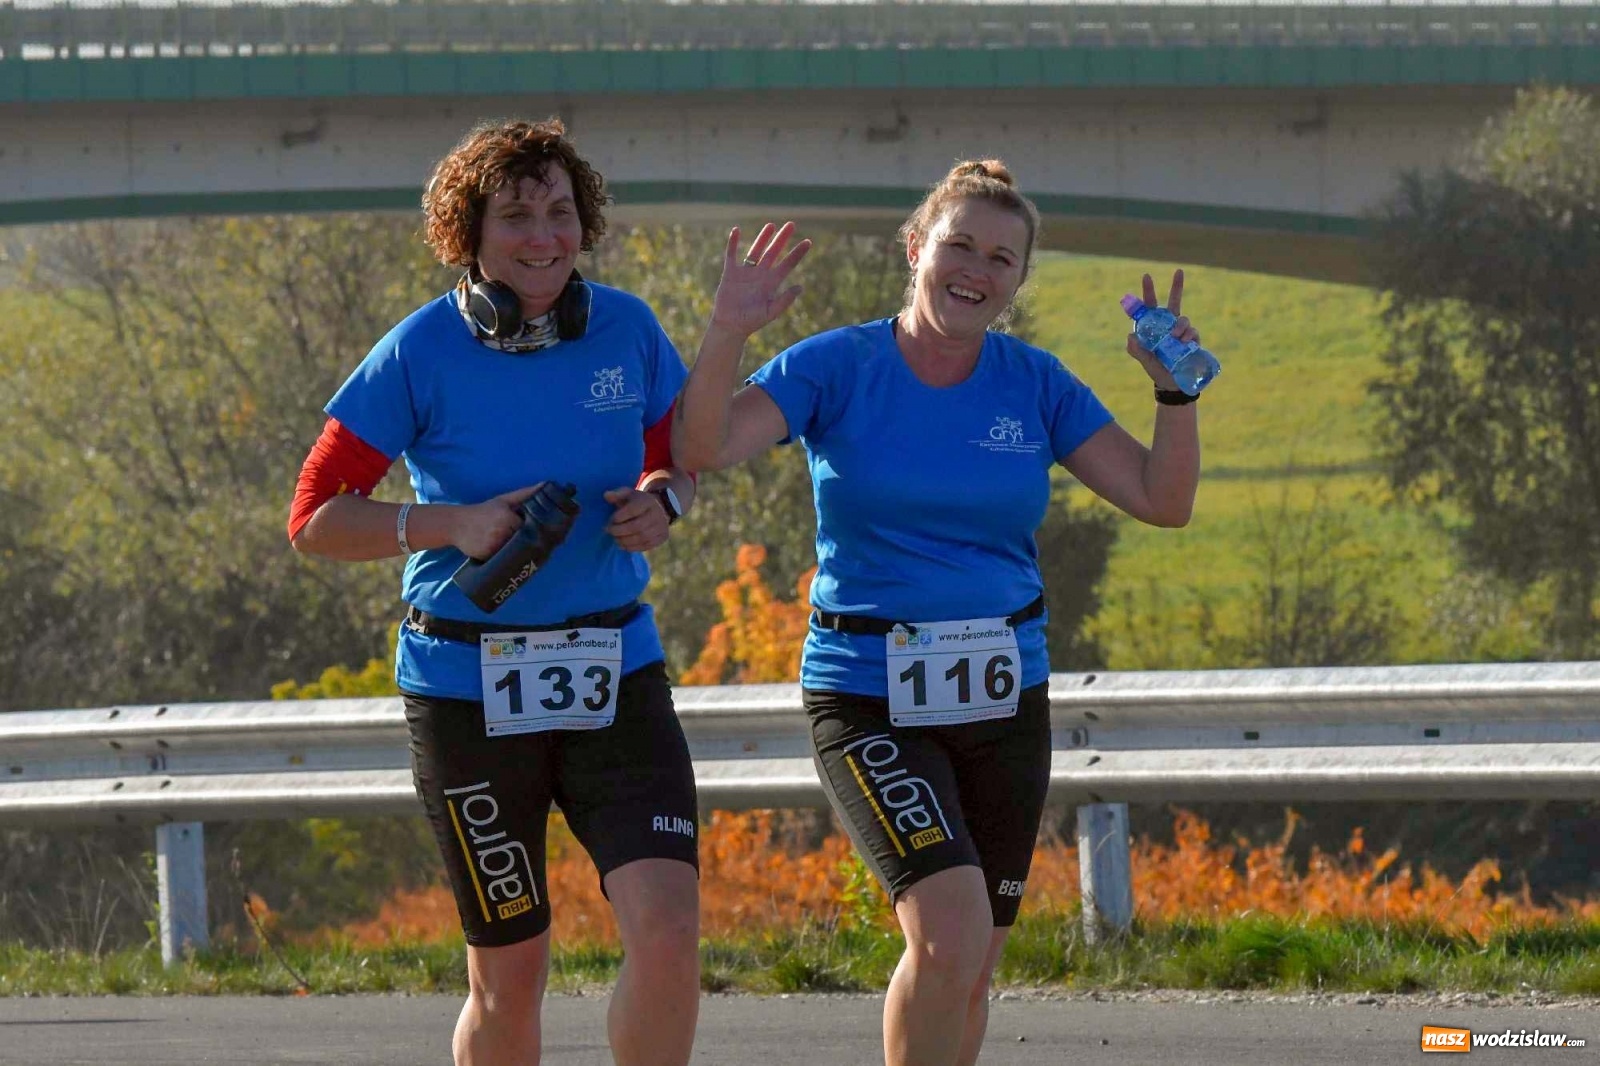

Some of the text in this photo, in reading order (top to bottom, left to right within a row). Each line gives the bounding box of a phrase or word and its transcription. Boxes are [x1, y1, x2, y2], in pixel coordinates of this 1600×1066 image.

[591, 375, 625, 400] Gryf
[989, 426, 1024, 444] Gryf
[533, 639, 617, 650] www.personalbest.pl
[495, 665, 612, 714] 133
[900, 654, 1015, 706] 116
[843, 733, 954, 839] agrol
[653, 815, 694, 839] ALINA
[913, 830, 943, 848] HBU
[444, 781, 540, 905] agrol
[501, 899, 531, 916] HBU
